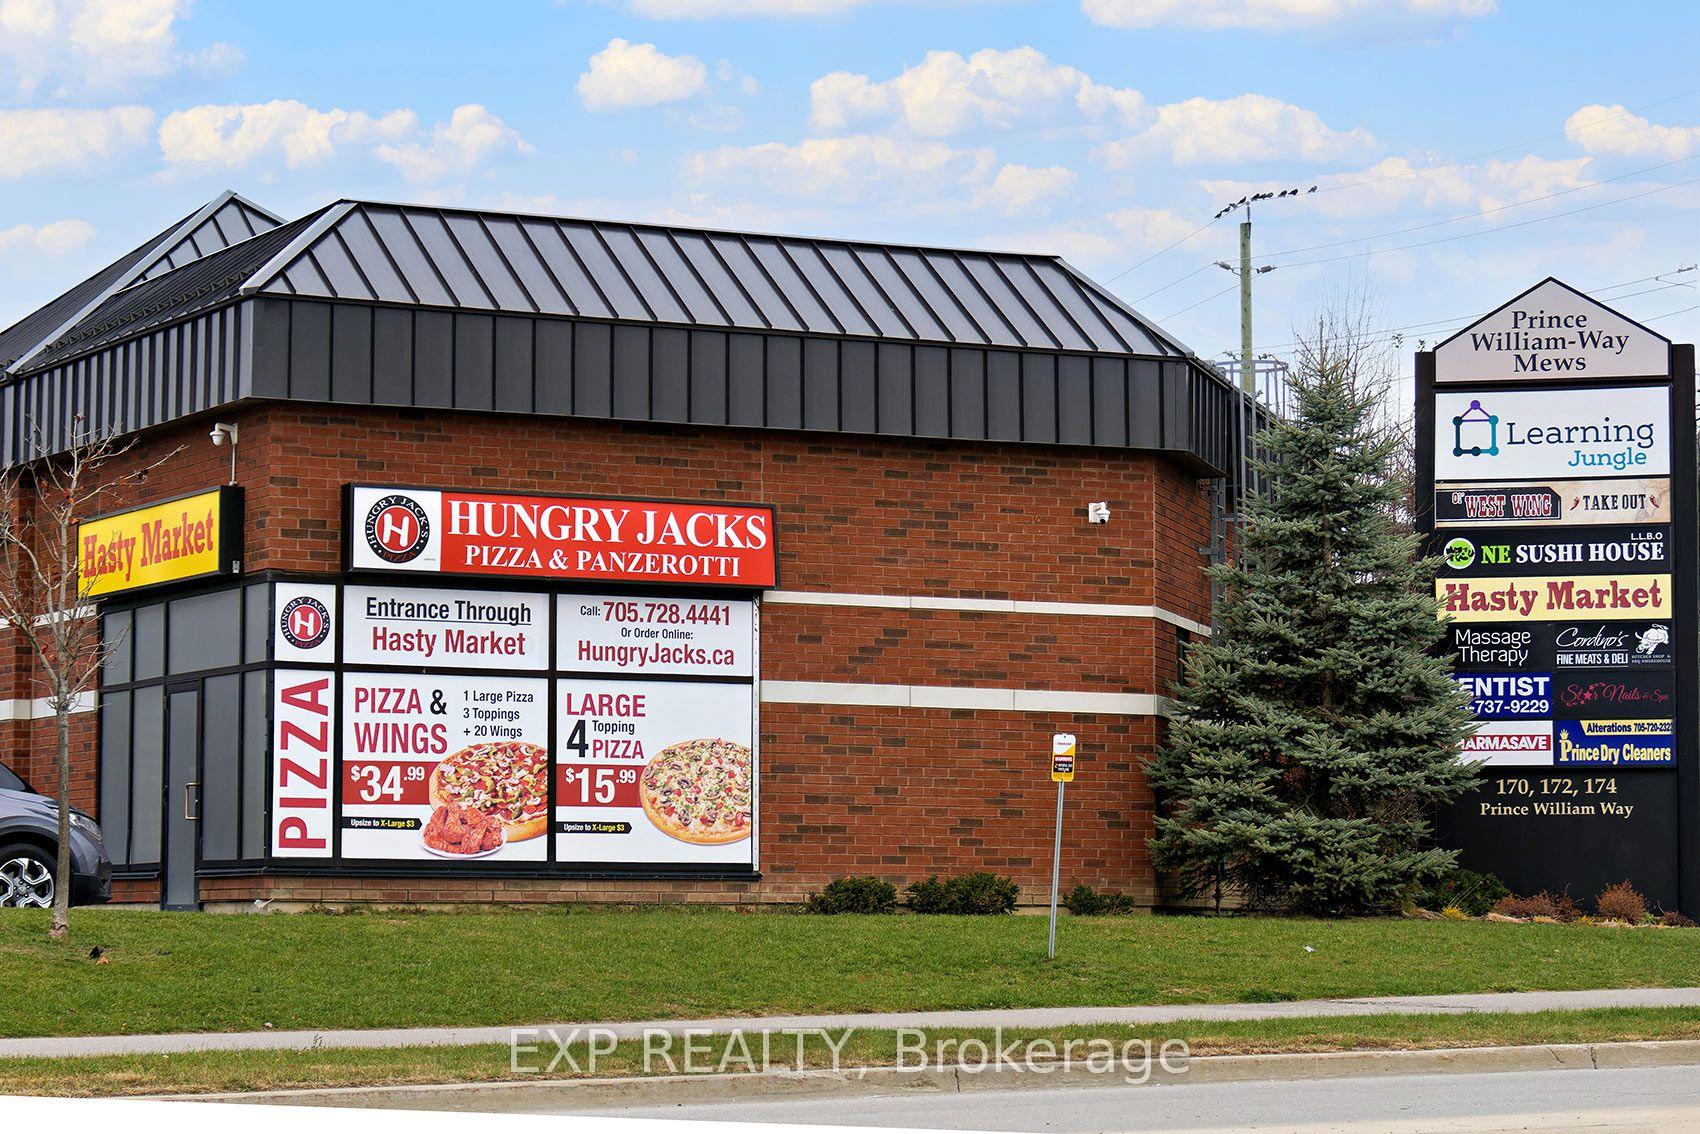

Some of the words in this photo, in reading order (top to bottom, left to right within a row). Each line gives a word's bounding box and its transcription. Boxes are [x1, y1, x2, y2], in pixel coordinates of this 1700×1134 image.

[1511, 310, 1588, 329] Prince
[1470, 330, 1630, 355] William-Way
[1513, 353, 1587, 373] Mews
[1506, 417, 1654, 448] Learning
[1568, 447, 1647, 470] Jungle
[1464, 494, 1506, 518] WEST
[1510, 493, 1552, 517] WING
[1582, 495, 1618, 511] TAKE
[1621, 494, 1646, 510] OUT
[382, 513, 409, 547] H
[447, 500, 631, 544] HUNGRY
[636, 509, 767, 550] JACKS
[83, 530, 137, 582] Hasty
[140, 508, 214, 568] Market
[1516, 543, 1583, 563] SUSHI
[1588, 541, 1664, 562] HOUSE
[465, 545, 544, 569] PIZZA
[548, 549, 569, 570] &
[576, 551, 741, 578] PANZEROTTI
[1445, 582, 1538, 617] Hasty
[1546, 578, 1663, 610] Market
[366, 596, 450, 620] Entrance
[455, 599, 531, 625] Through
[580, 604, 600, 617] Call:
[603, 601, 730, 626] 705.728.4441
[294, 610, 314, 637] H
[620, 627, 632, 638] Or
[635, 628, 660, 639] Order
[662, 628, 694, 640] Online:
[371, 626, 438, 657] Hasty
[444, 630, 526, 656] Market
[1455, 629, 1531, 650] Massage
[577, 639, 735, 672] HungryJacks.ca
[1457, 646, 1529, 666] Therapy
[1556, 653, 1574, 665] FINE
[1575, 653, 1602, 665] MEATS
[1603, 653, 1610, 664] &
[1612, 653, 1629, 664] DELI
[463, 690, 469, 701] 1
[472, 690, 503, 705] Large
[506, 692, 534, 703] Pizza
[1451, 676, 1550, 697] ENTIST
[354, 687, 422, 714] PIZZA
[430, 689, 447, 715] &
[566, 693, 646, 717] LARGE
[463, 707, 470, 719] 3
[472, 708, 520, 722] Toppings
[353, 722, 448, 755] WINGS
[463, 727, 470, 735] +
[474, 725, 487, 737] 20
[489, 725, 523, 739] Wings
[566, 719, 589, 758] 4
[592, 720, 635, 735] Topping
[1587, 722, 1632, 732] Alterations
[592, 739, 644, 759] PIZZA
[1559, 739, 1600, 761] Prince
[1600, 744, 1620, 765] Dry
[1622, 743, 1671, 761] Cleaners
[278, 678, 329, 849] PIZZA
[1496, 780, 1534, 797] 170,
[1540, 779, 1579, 796] 172,
[1584, 778, 1617, 794] 174
[1480, 804, 1529, 816] Prince
[1535, 802, 1596, 816] William
[1600, 802, 1634, 819] Way
[350, 819, 372, 828] Upsize
[380, 820, 406, 829] X-Large
[406, 820, 415, 828] $3
[563, 823, 584, 832] Upsize
[592, 824, 616, 833] X-Large
[616, 824, 625, 832] $3
